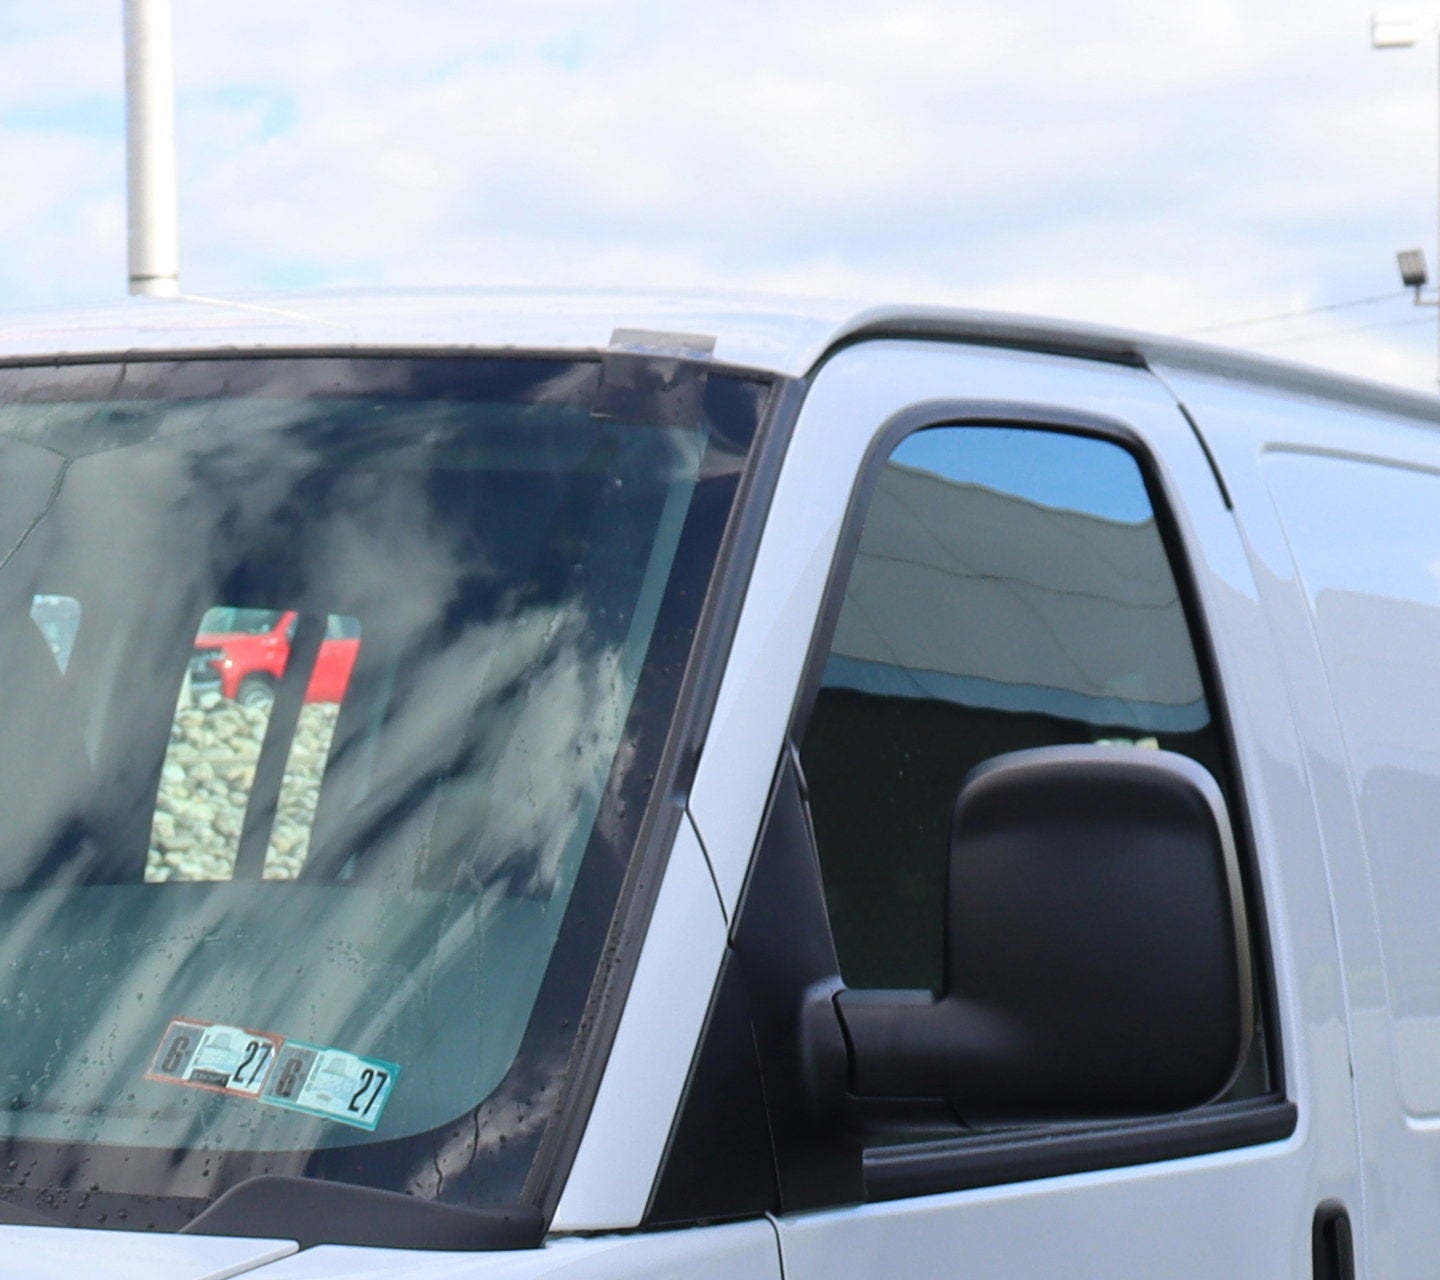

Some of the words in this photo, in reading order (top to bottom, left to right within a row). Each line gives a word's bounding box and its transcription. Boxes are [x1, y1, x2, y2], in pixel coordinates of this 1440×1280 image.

[161, 1036, 191, 1073] 6
[233, 1040, 274, 1088] 27
[275, 1058, 303, 1097] 6
[348, 1068, 389, 1118] 27
